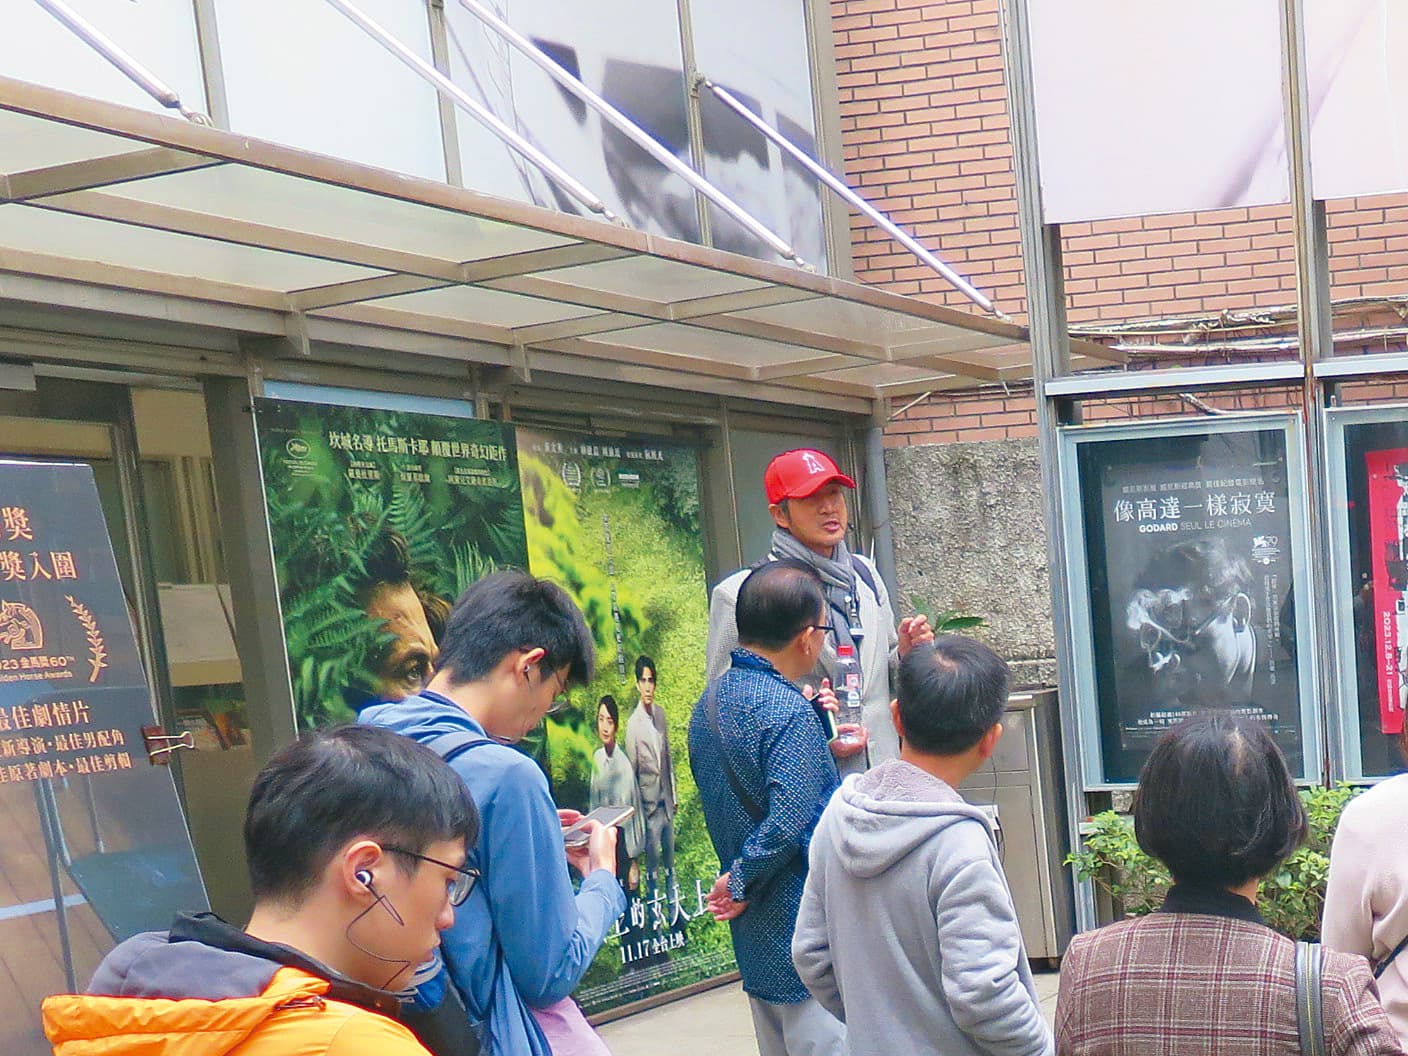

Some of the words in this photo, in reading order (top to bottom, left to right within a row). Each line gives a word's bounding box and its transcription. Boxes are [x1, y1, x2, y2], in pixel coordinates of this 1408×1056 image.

[328, 431, 374, 452] 坎城名導
[1113, 490, 1276, 523] 像高達一樣寂寞
[1138, 522, 1179, 534] GODARD
[1180, 520, 1203, 532] SEUL
[1204, 519, 1215, 530] LE
